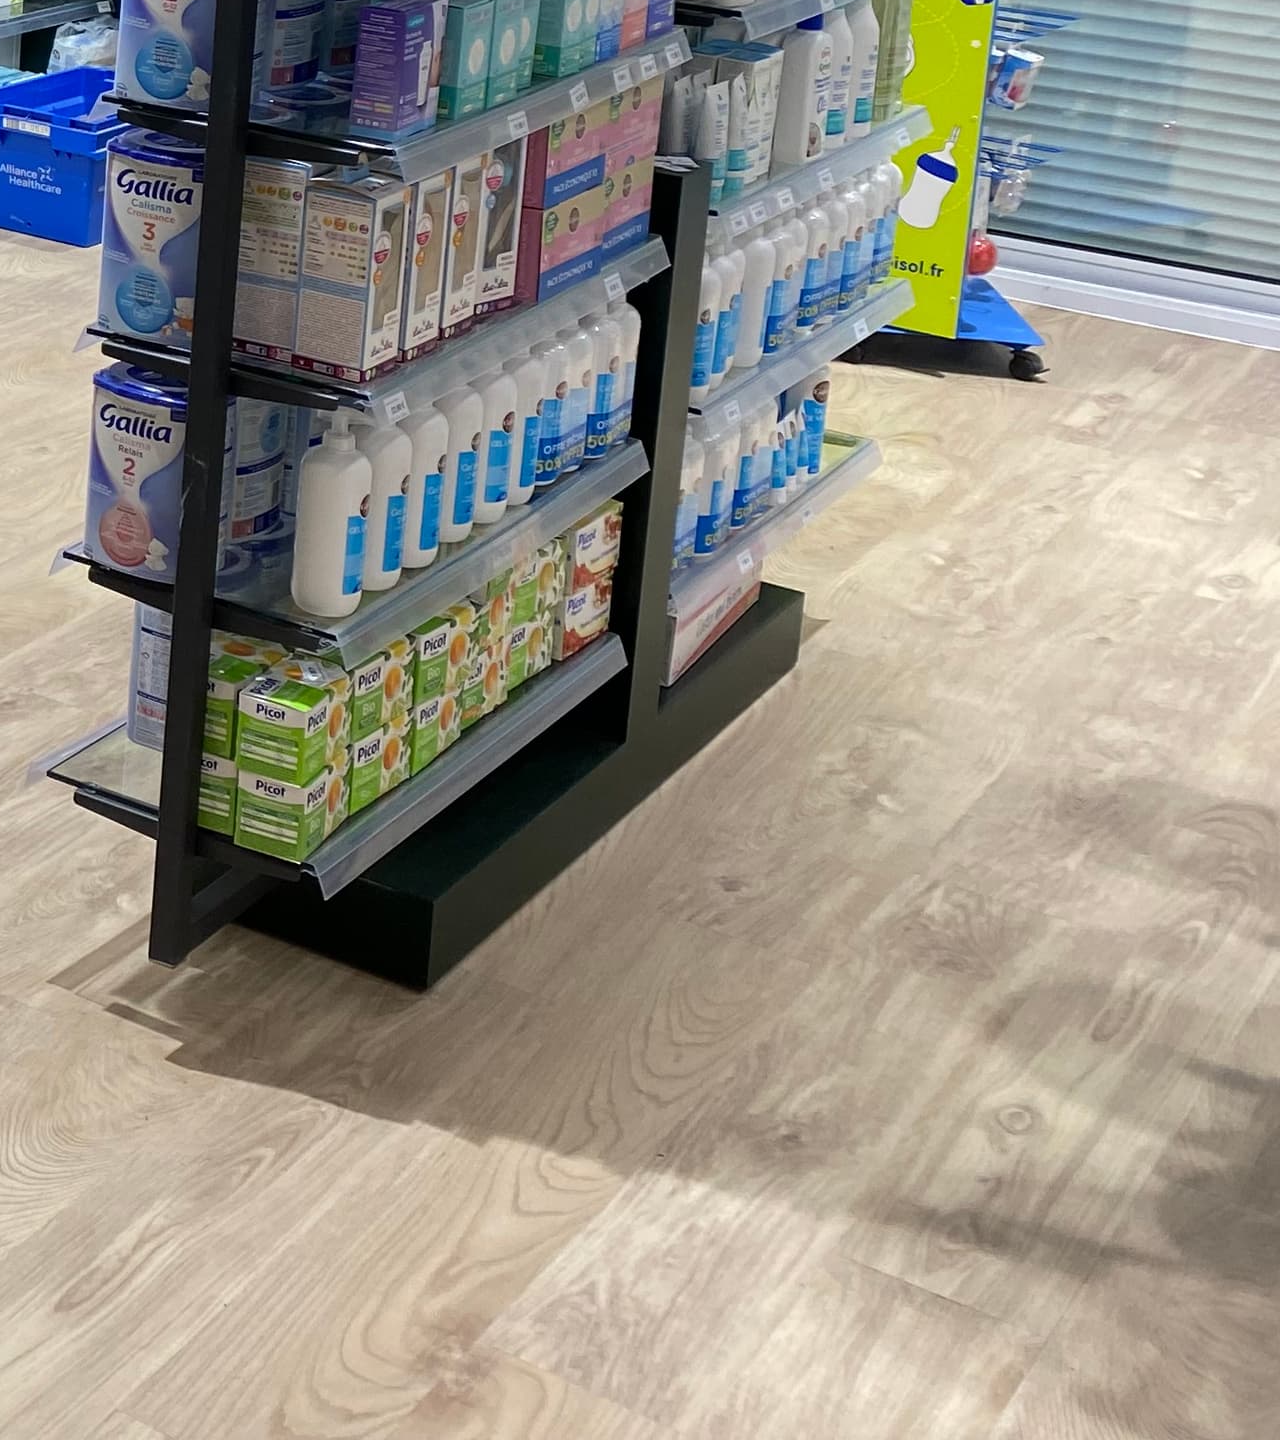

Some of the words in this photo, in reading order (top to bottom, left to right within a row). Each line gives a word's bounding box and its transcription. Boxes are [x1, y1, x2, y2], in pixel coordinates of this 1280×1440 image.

[0, 163, 38, 180] Alliance
[9, 175, 62, 195] Healthcare
[116, 169, 194, 206] Gallia
[126, 206, 176, 224] Croissance
[131, 198, 172, 214] Calisma
[142, 222, 156, 240] 3
[99, 403, 172, 444] Gallia
[118, 444, 143, 458] Relais
[123, 458, 135, 477] 2
[424, 633, 447, 654] Picot
[359, 667, 381, 689] Picot
[256, 704, 285, 721] Picot
[308, 706, 327, 731] Picot
[420, 701, 439, 723] Picot
[358, 738, 380, 761] Picot
[256, 780, 285, 797] Picot
[307, 782, 326, 808] Picot
